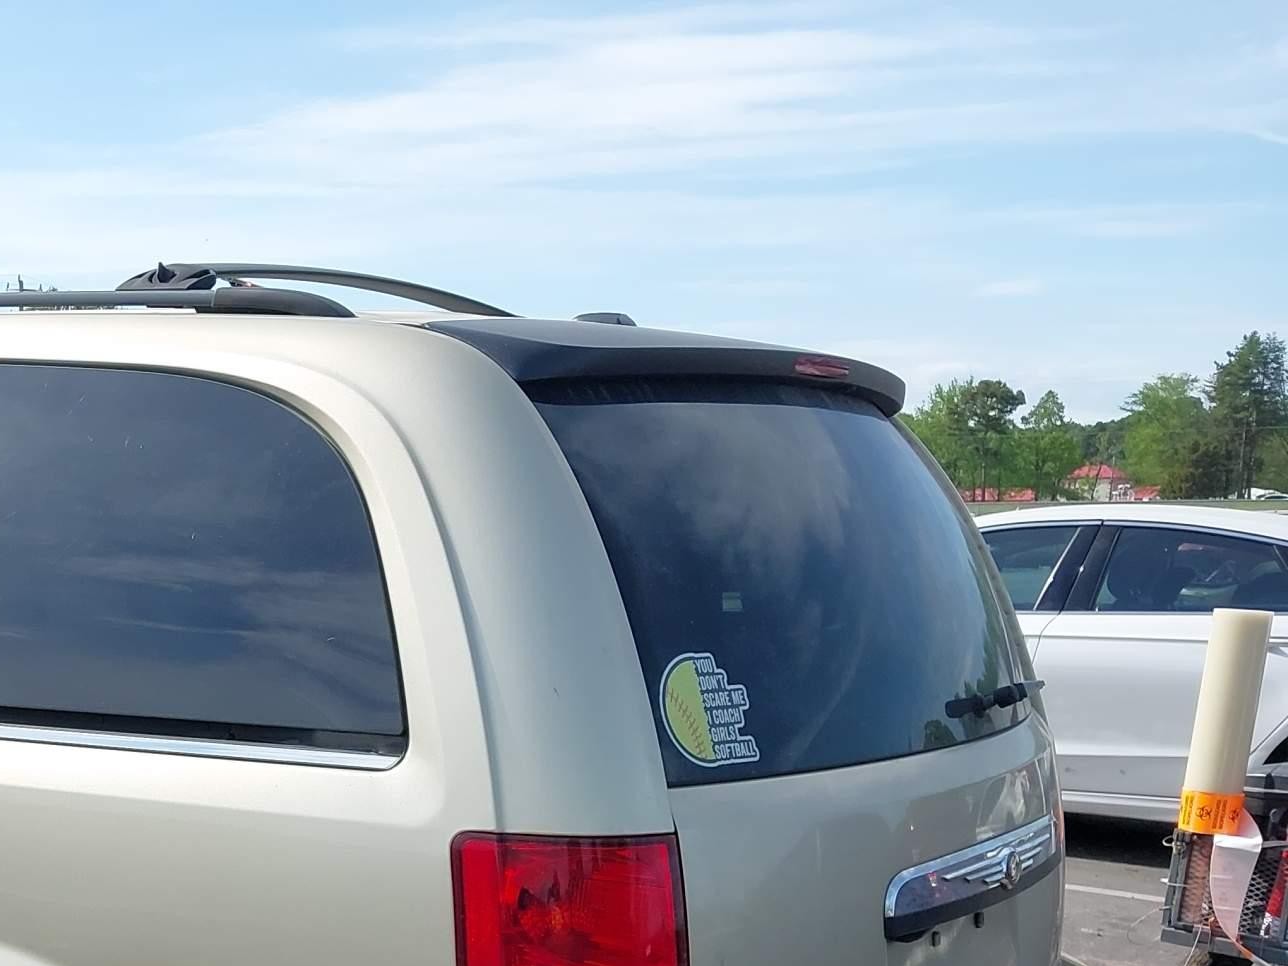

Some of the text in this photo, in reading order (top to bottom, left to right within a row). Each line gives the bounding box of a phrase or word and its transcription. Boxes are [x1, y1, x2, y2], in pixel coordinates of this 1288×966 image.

[695, 658, 713, 673] YOU
[699, 675, 725, 691] DON'T
[703, 690, 745, 708] SCARE ME
[712, 708, 741, 725] COACH
[711, 725, 736, 742] GIRLS
[714, 741, 756, 760] SOFTBALL
